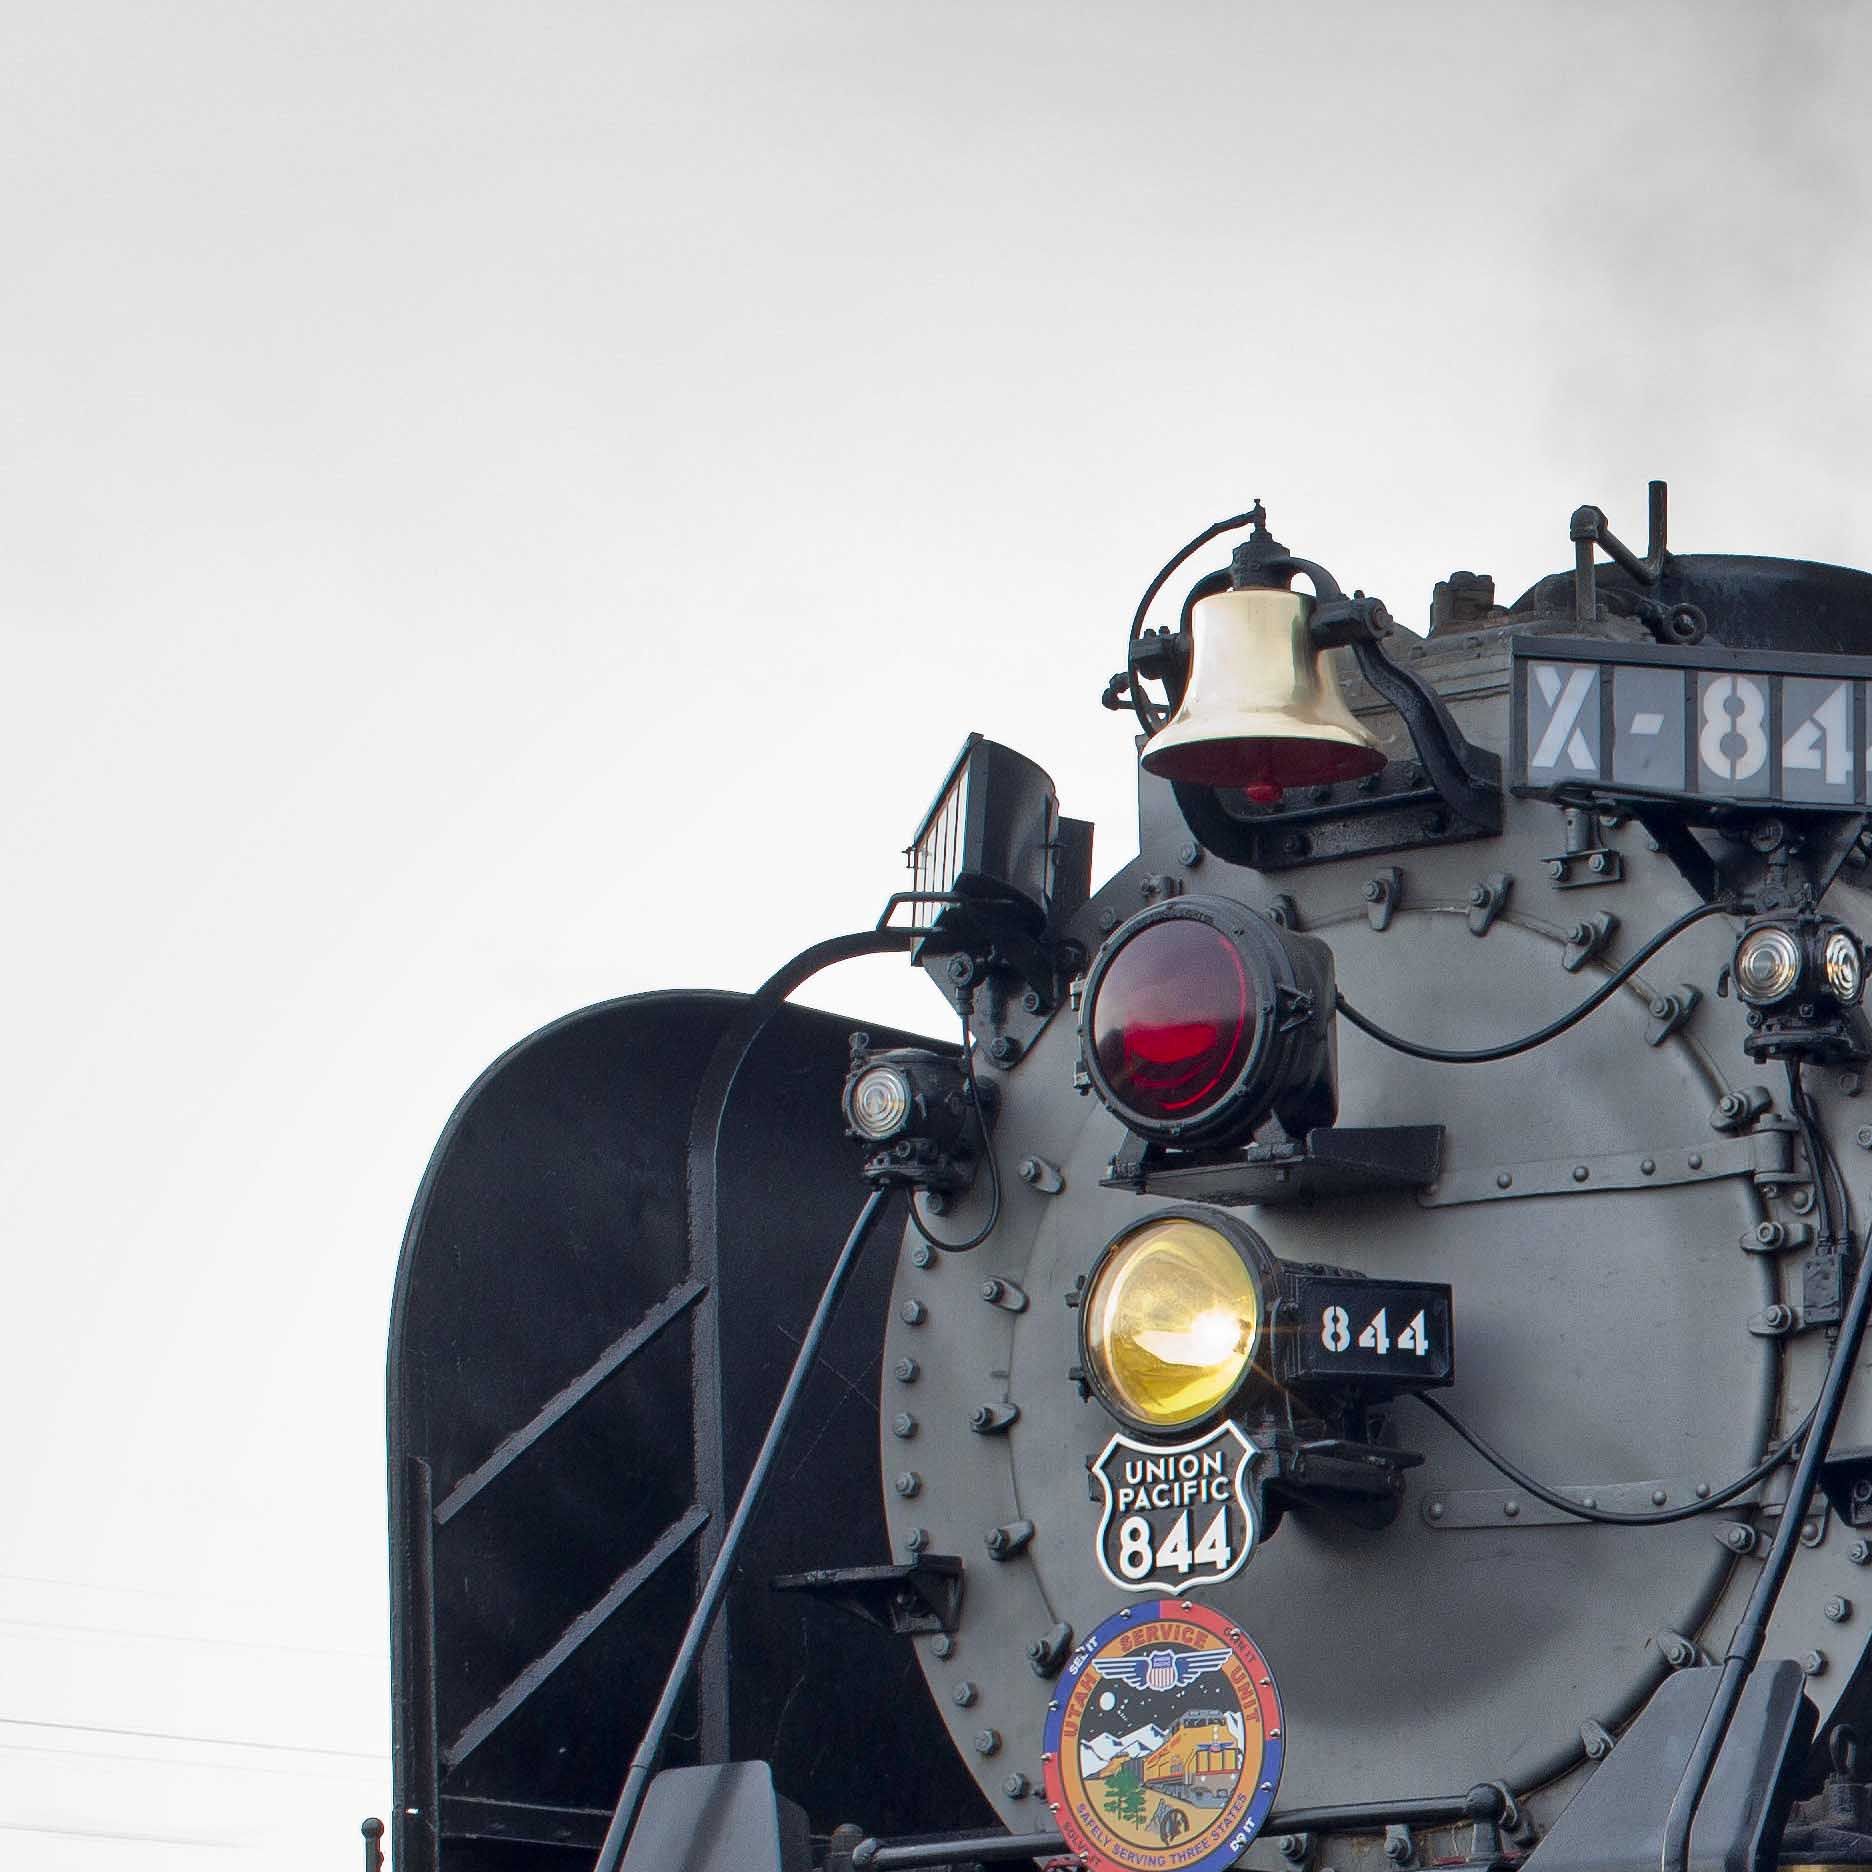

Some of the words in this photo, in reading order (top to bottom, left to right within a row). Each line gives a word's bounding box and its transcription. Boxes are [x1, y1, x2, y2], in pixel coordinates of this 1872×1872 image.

[1321, 1305, 1429, 1356] 844
[1119, 1477, 1229, 1511] PACIFIC
[1125, 1451, 1223, 1485] UNION
[1120, 1504, 1231, 1579] 844
[1063, 1672, 1097, 1738] UTAH
[1119, 1623, 1209, 1652] SERVICE
[1230, 1665, 1260, 1723] UNIT
[1076, 1802, 1111, 1847] SAFELY
[1111, 1843, 1166, 1867] SERVING
[1169, 1838, 1210, 1865] THREE
[1211, 1792, 1248, 1841] STATES
